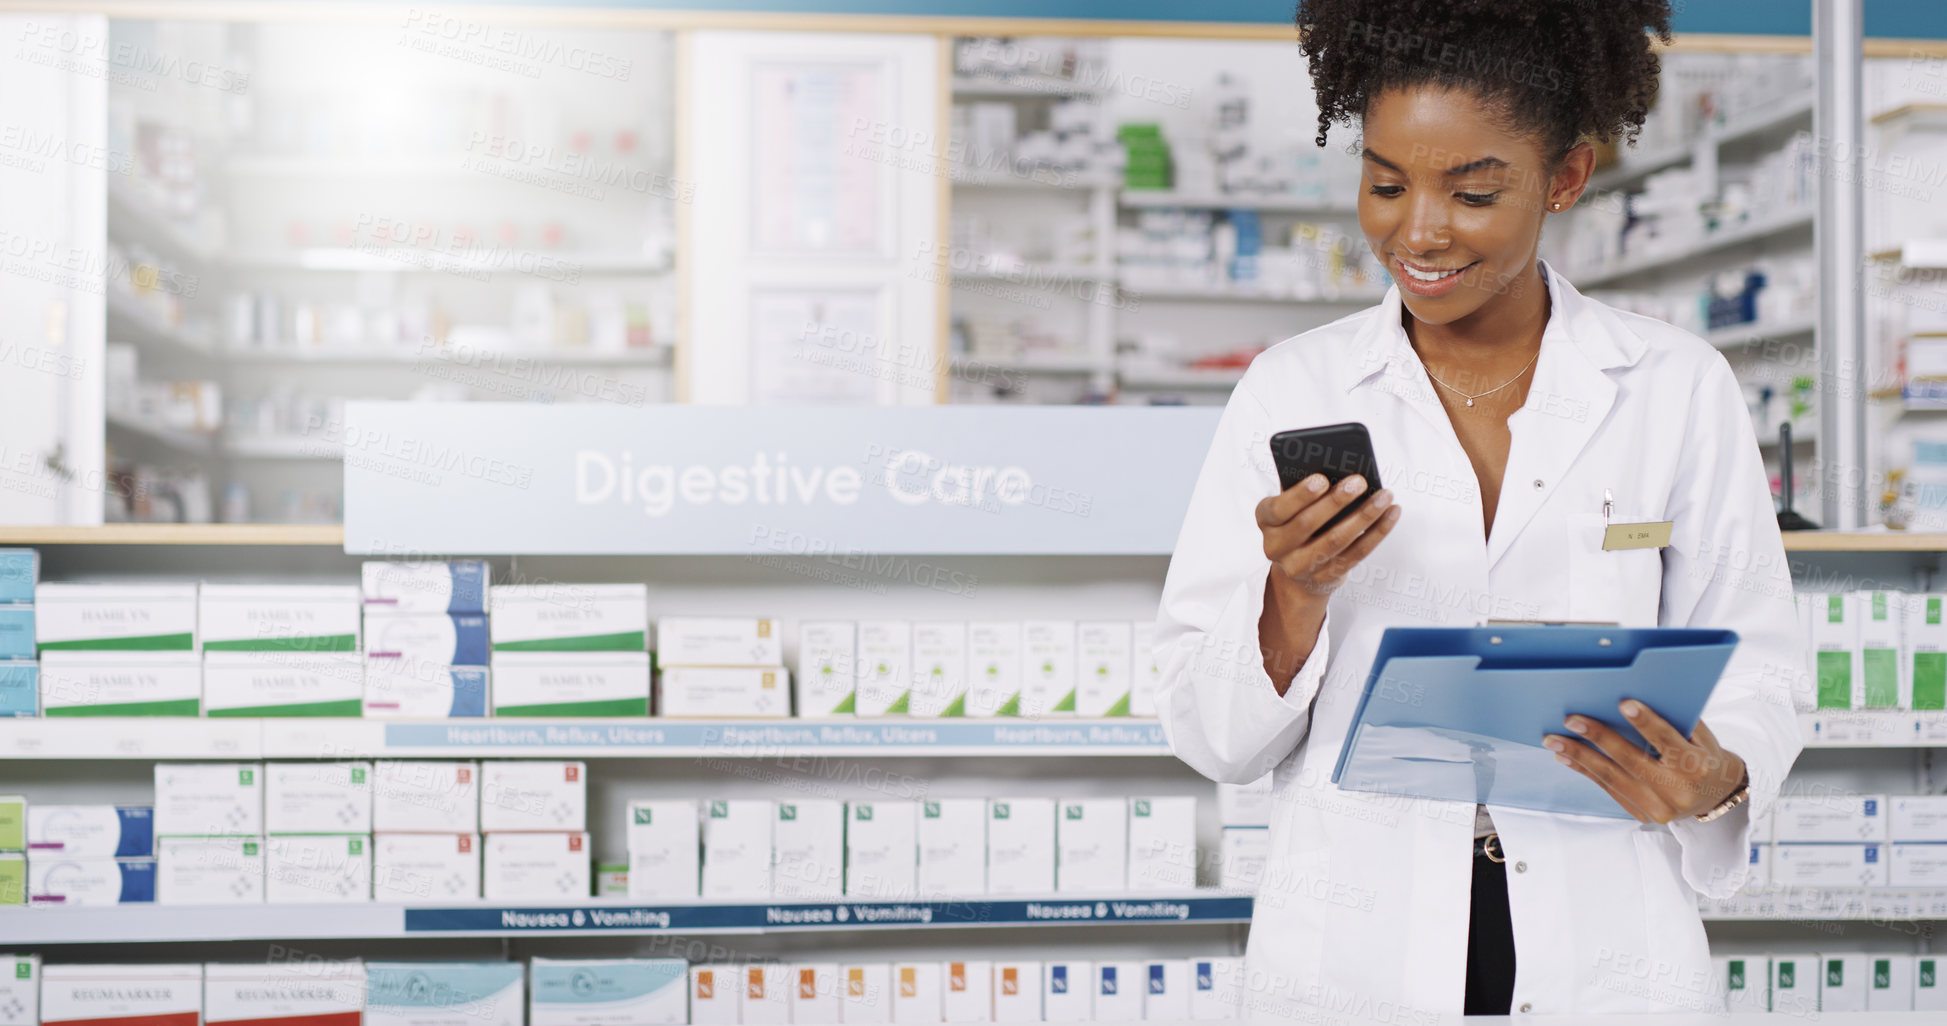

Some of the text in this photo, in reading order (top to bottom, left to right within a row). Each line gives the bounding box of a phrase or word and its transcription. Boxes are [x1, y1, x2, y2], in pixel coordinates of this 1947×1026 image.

[575, 450, 1033, 517] Digestive Care
[447, 726, 664, 744] Heartburn, Reflux, Ulcers
[883, 725, 937, 743] Ulcers
[502, 910, 670, 927] Nausea & Vomiting
[766, 905, 933, 924] Nausea & Vomiting
[1026, 902, 1189, 920] Nausea & Vomiting
